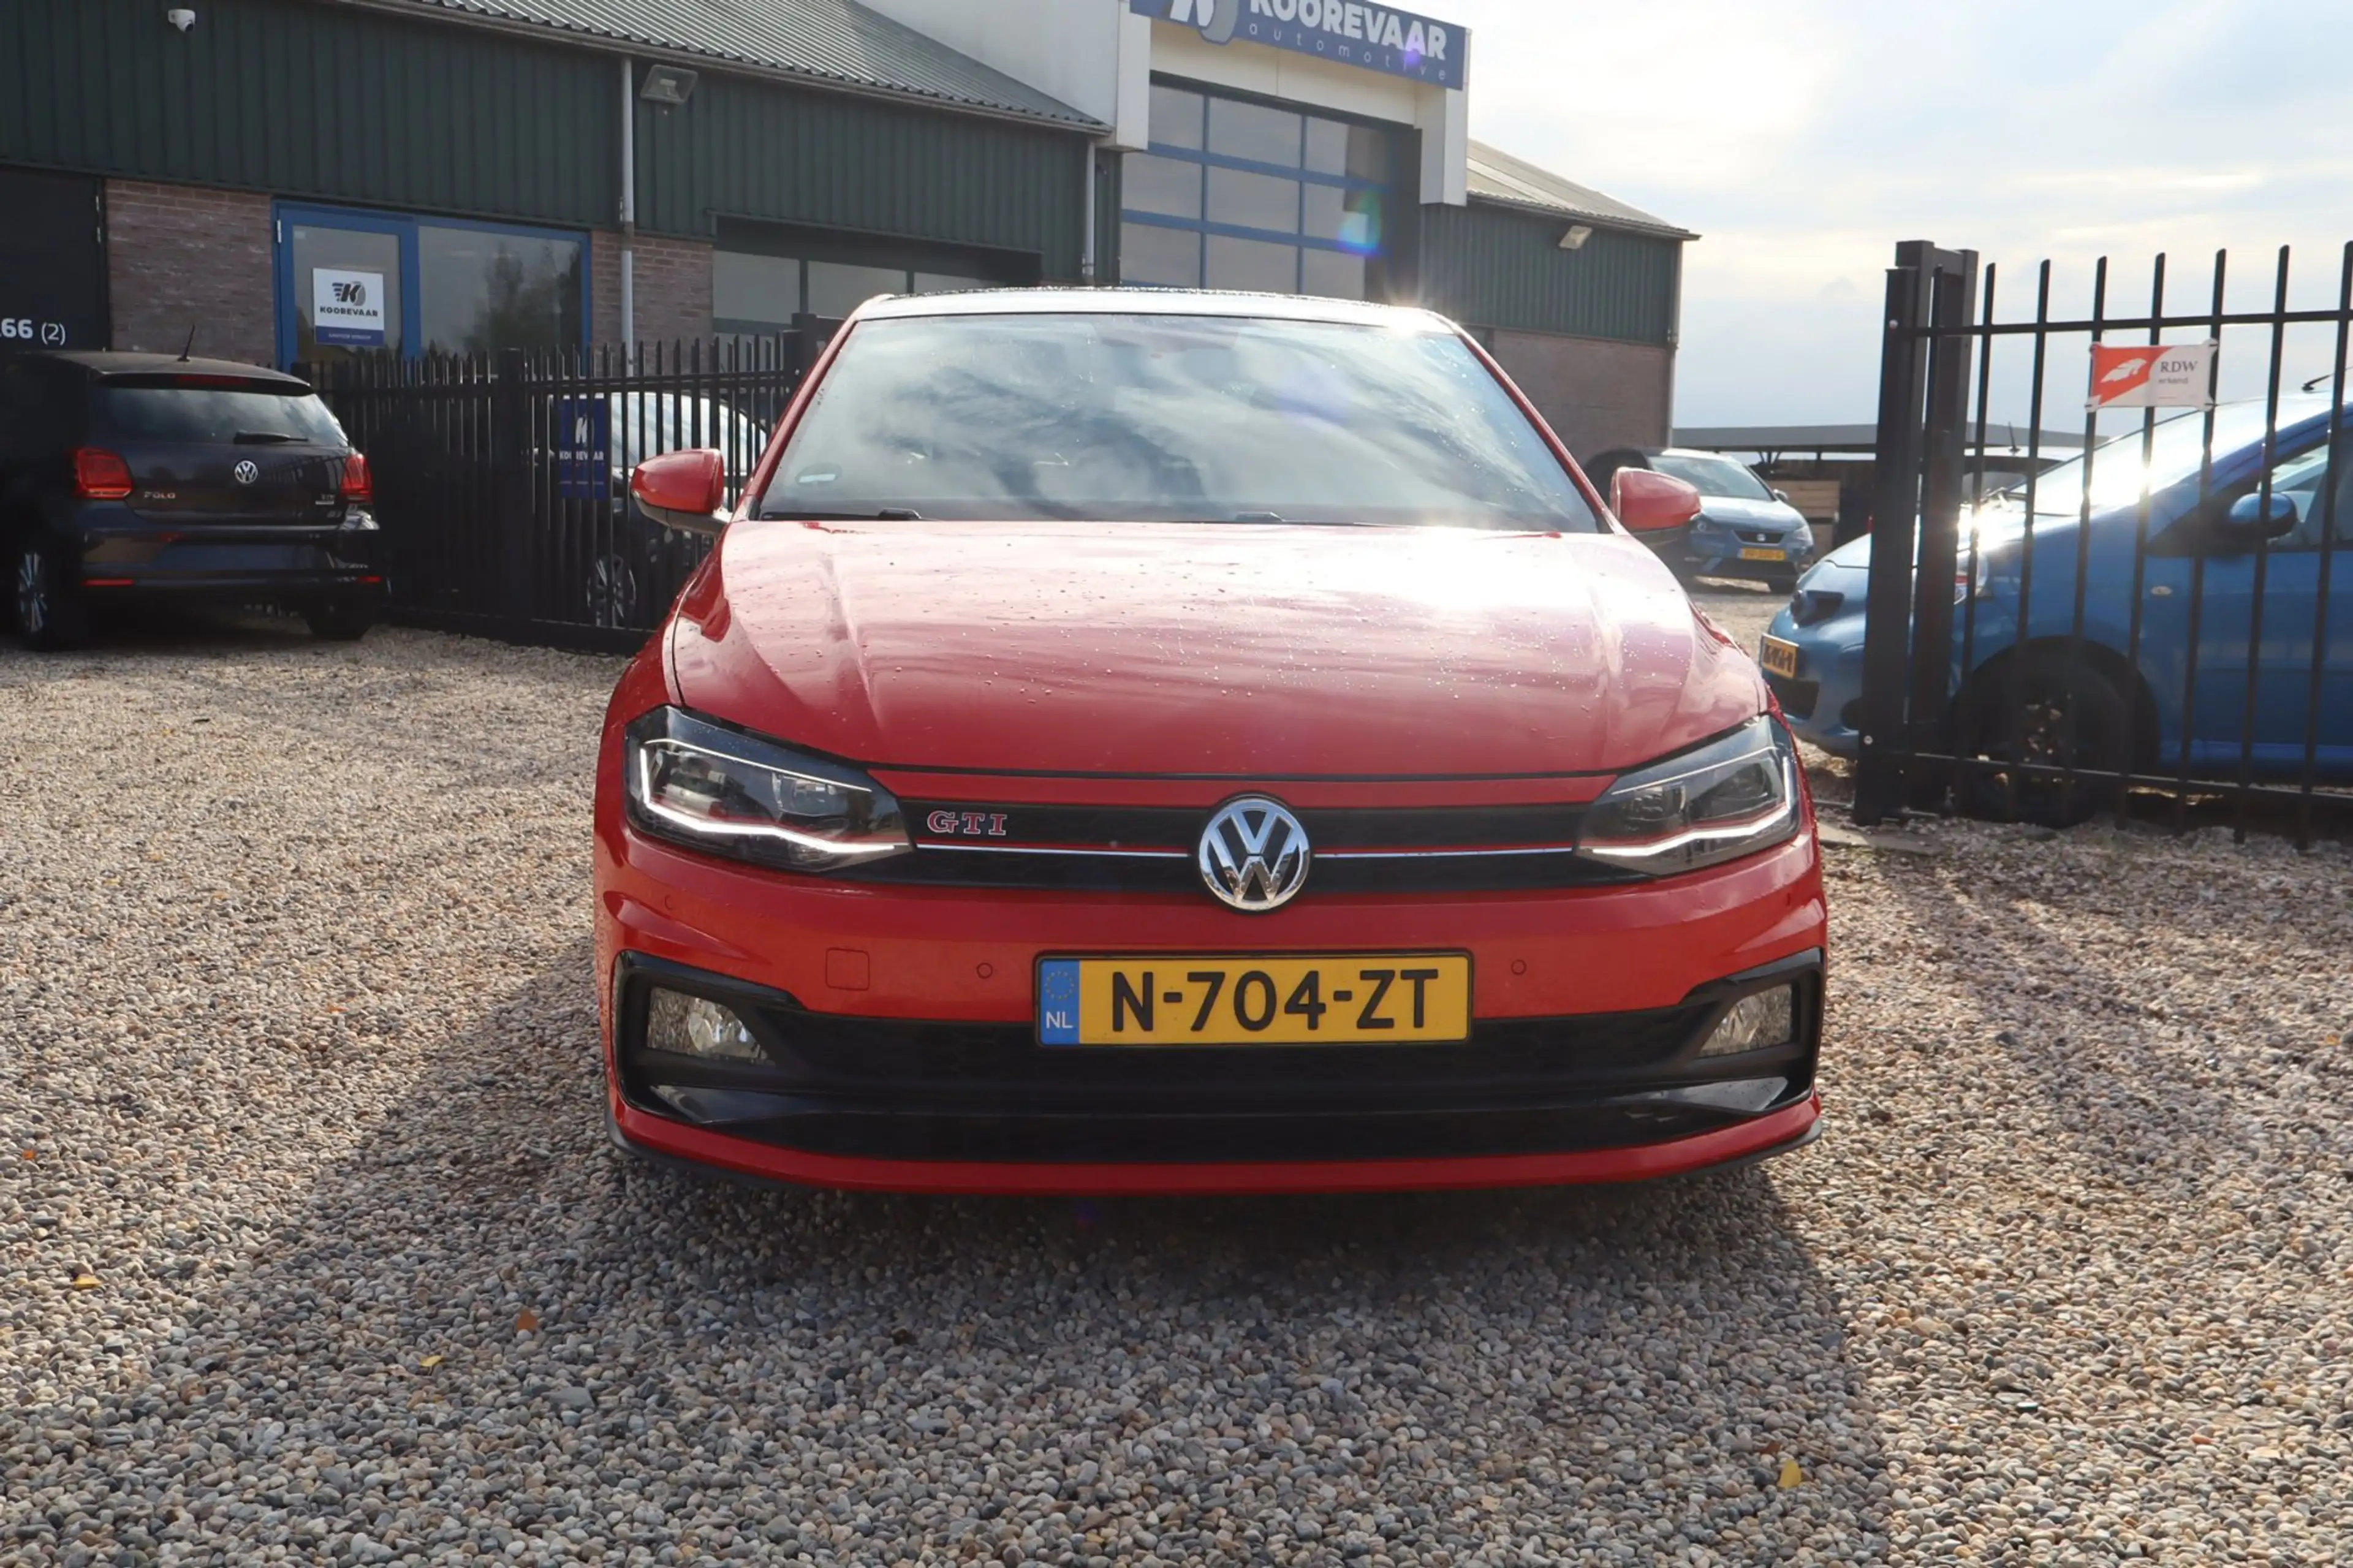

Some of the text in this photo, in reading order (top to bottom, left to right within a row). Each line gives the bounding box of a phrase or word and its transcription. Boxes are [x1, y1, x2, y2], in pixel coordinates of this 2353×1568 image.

[1249, 23, 1446, 80] automotive
[320, 306, 378, 317] KOOREVAAR
[41, 322, 66, 346] (2)
[2161, 360, 2198, 373] RDW
[927, 810, 1008, 836] GTI
[1046, 969, 1439, 1032] NL N-704-ZT
